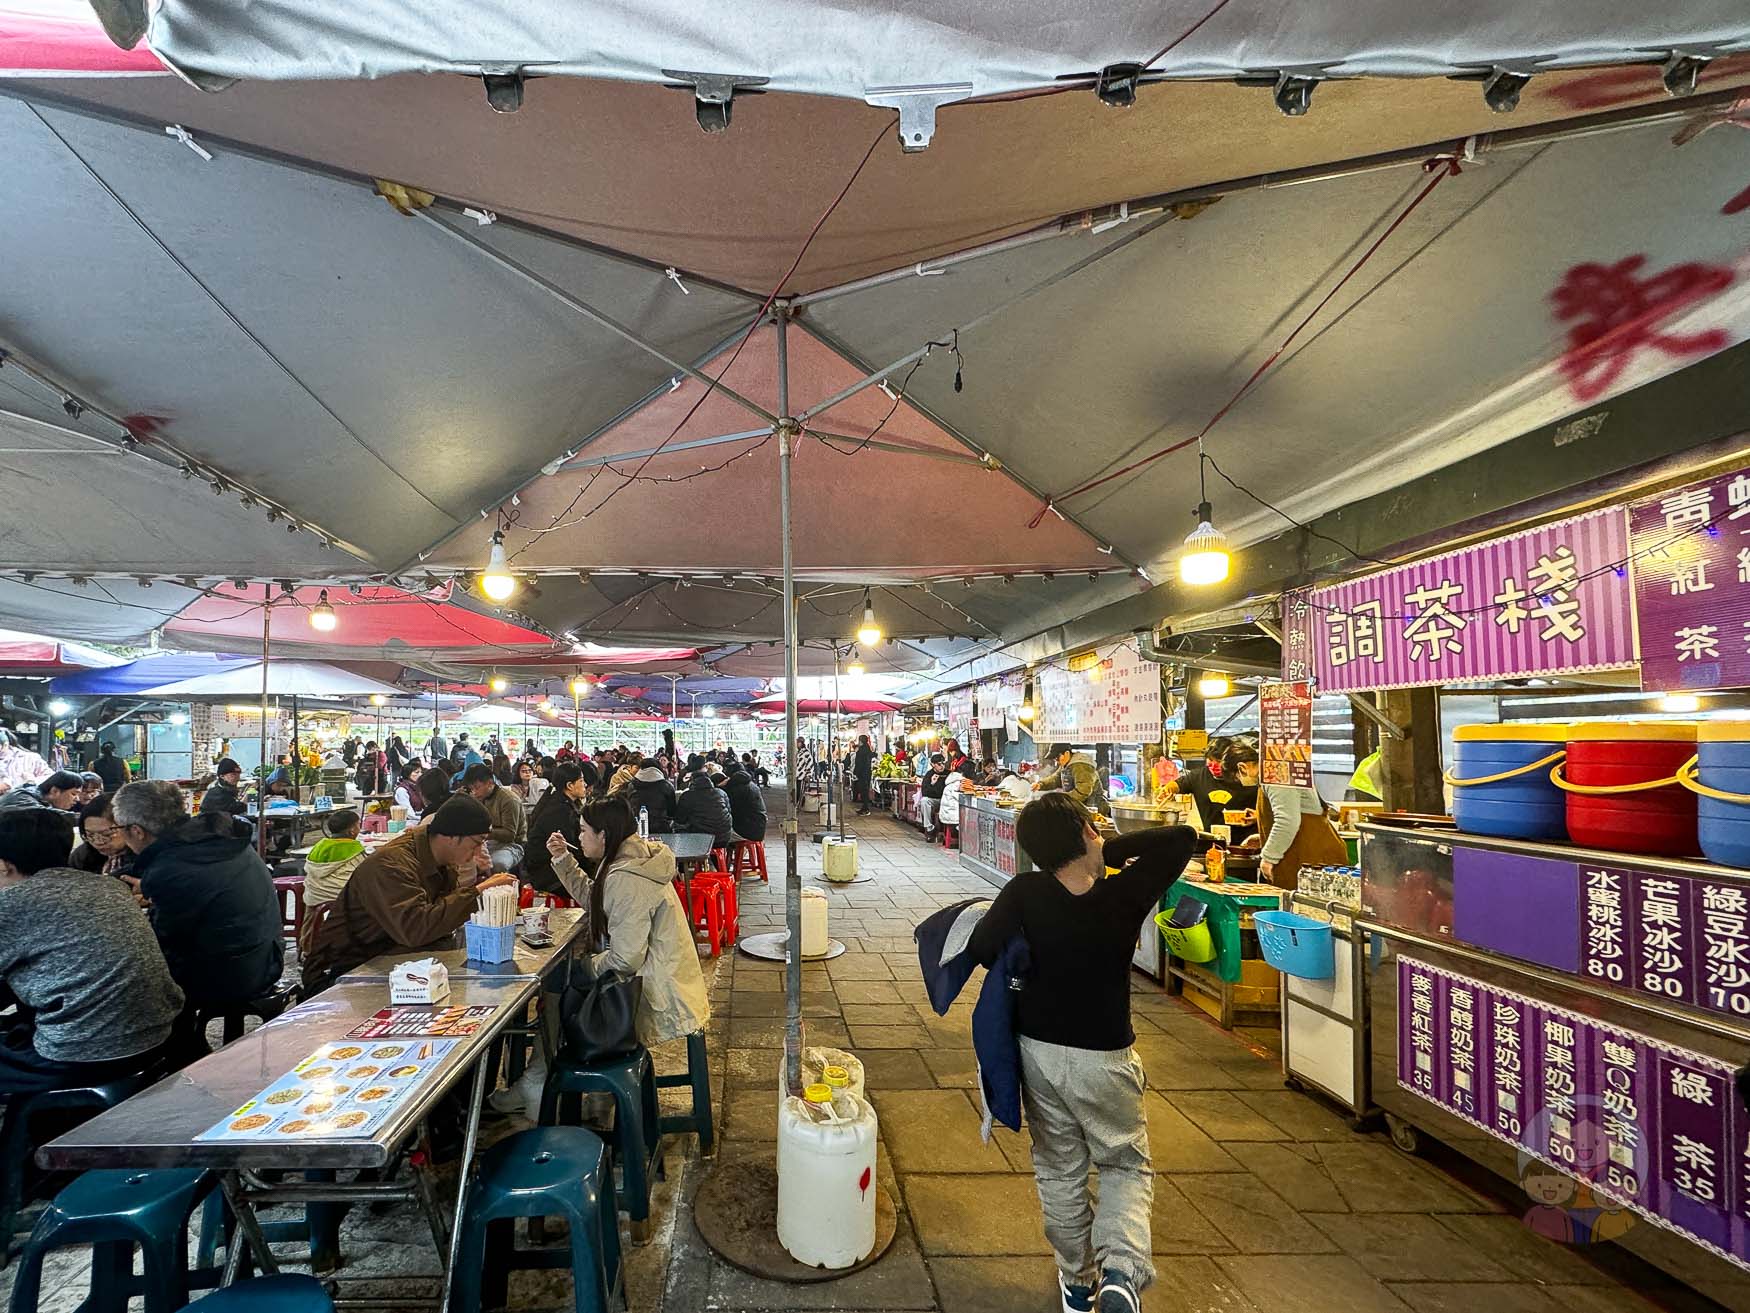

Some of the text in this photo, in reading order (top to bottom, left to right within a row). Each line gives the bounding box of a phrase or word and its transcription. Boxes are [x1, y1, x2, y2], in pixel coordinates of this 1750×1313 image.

[1289, 599, 1309, 681] 冷熱飲
[1325, 545, 1585, 667] 調茶棧
[1586, 870, 1624, 982] 水蜜桃冰沙 80
[1640, 878, 1684, 998] 芒果冰沙 80
[1702, 885, 1750, 1015] 綠豆冰沙 70
[1411, 973, 1433, 1090] 麥香紅茶 35
[1450, 986, 1474, 1112] 香醇奶茶 45
[1493, 1001, 1522, 1136] 珍珠奶茶 50
[1543, 1019, 1576, 1164] 椰果奶茶 50
[1602, 1040, 1638, 1195] 雙Q奶茶 50
[1673, 1167, 1715, 1200] 35
